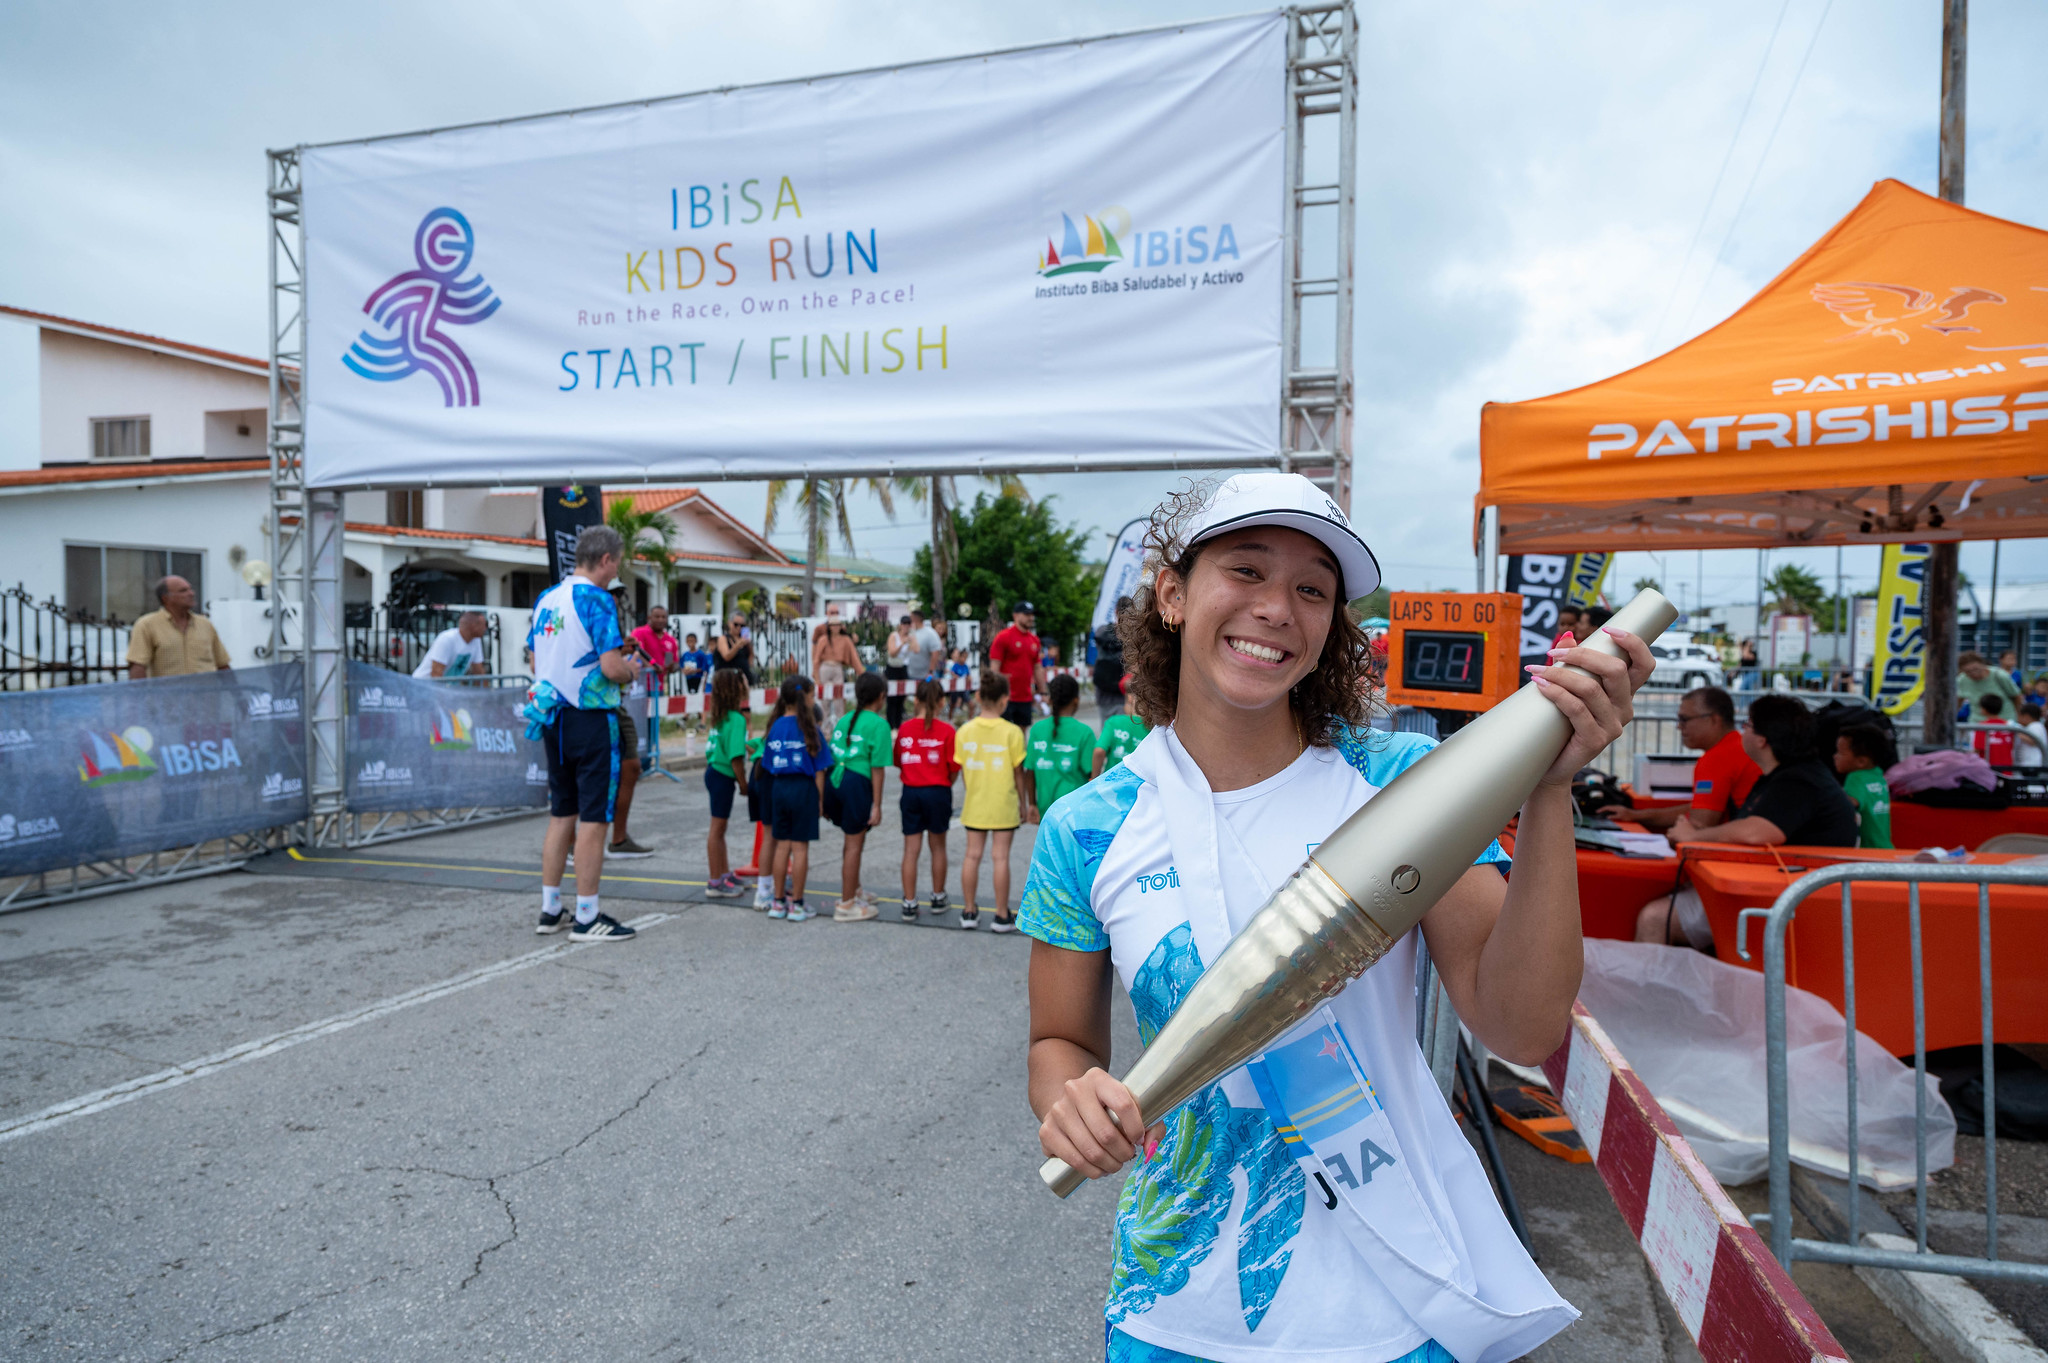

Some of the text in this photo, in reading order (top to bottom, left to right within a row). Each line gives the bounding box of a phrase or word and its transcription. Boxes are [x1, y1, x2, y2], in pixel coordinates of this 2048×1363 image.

[672, 176, 802, 230] IBiSA
[626, 228, 878, 294] KIDS RUN
[1132, 223, 1240, 269] IBiSA
[1035, 270, 1244, 298] Instituto Biba Saludabel y Activo
[577, 284, 914, 326] Run the Race, Own the Pace!
[558, 341, 705, 391] START
[770, 325, 948, 381] FINISH
[1771, 361, 2007, 396] PATRISHI
[1393, 600, 1496, 624] LAPS TO GO
[160, 737, 243, 777] IBiSA
[474, 727, 518, 753] IBiSA
